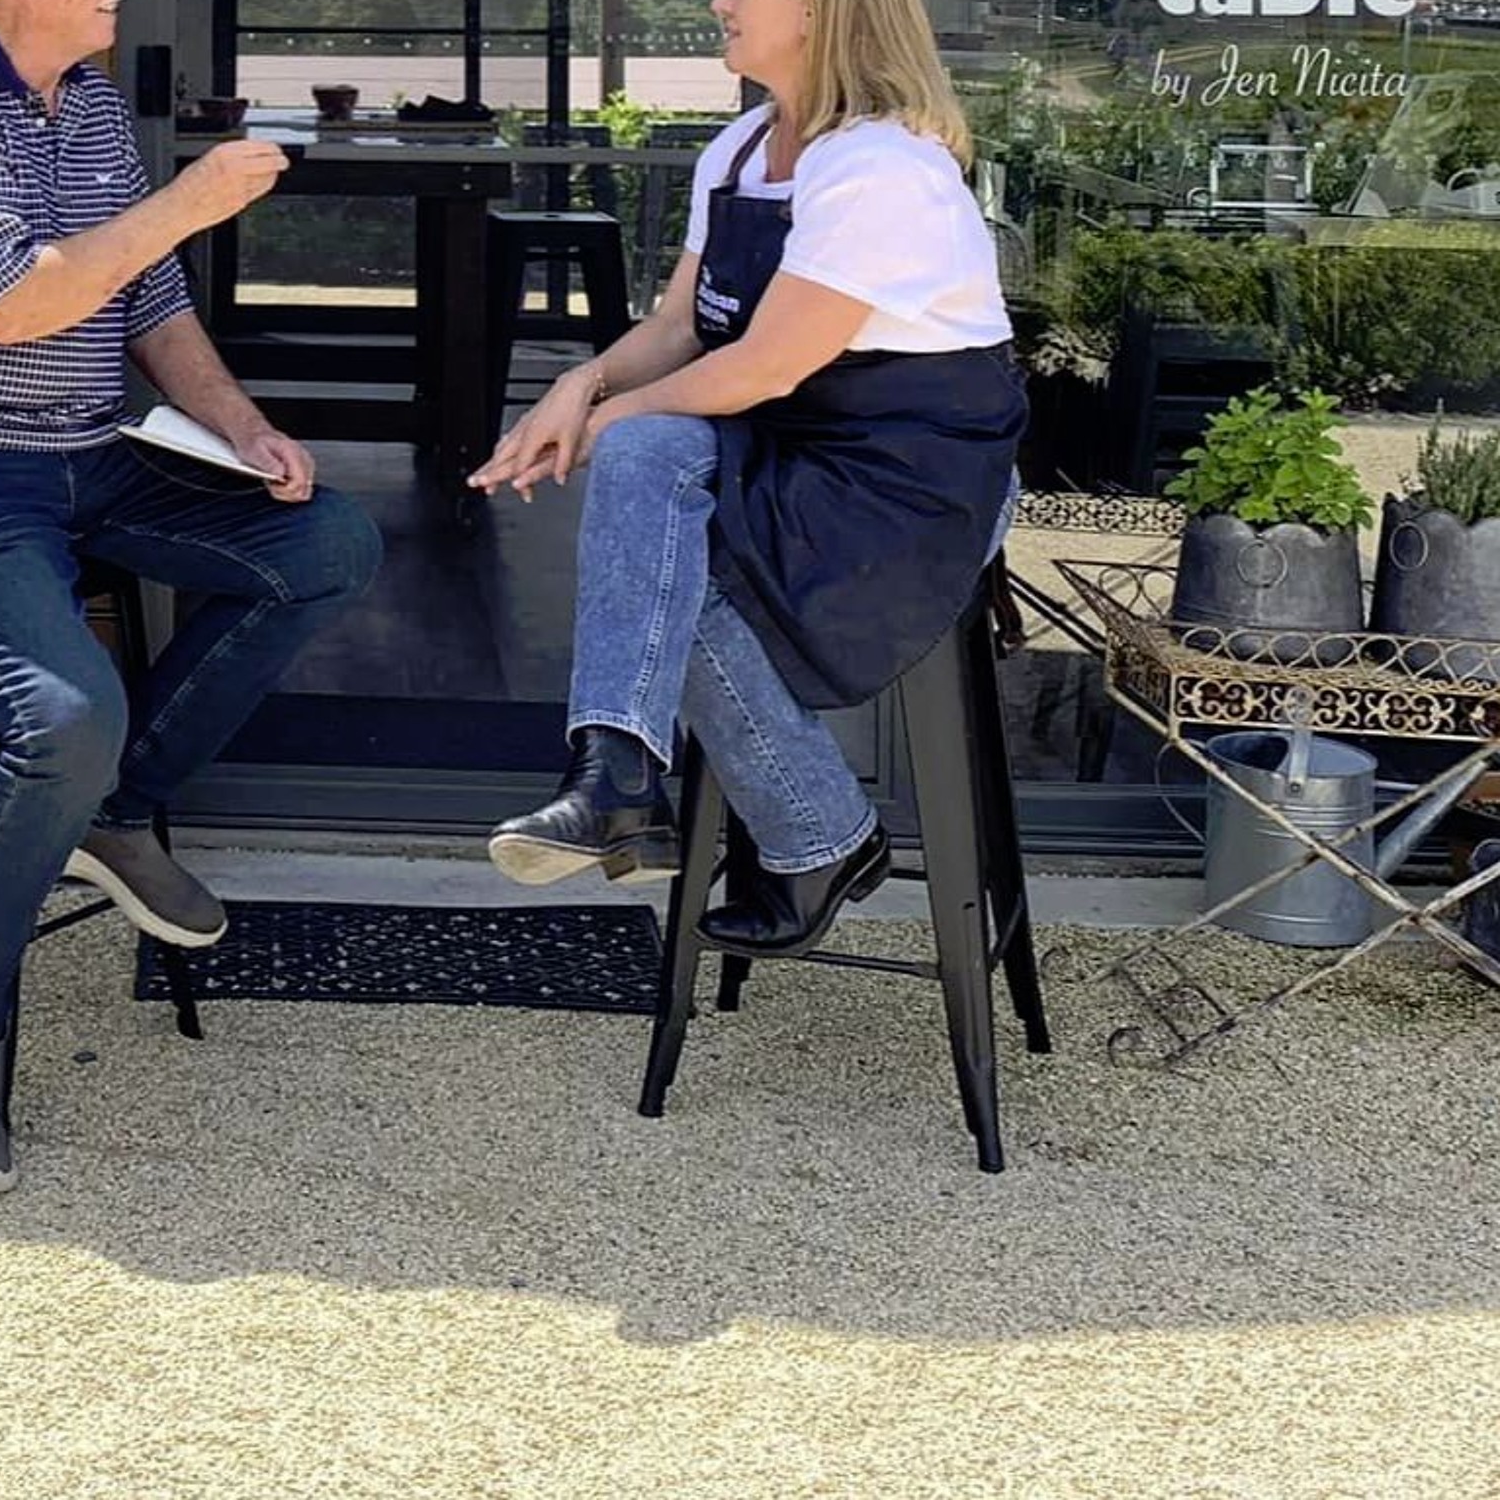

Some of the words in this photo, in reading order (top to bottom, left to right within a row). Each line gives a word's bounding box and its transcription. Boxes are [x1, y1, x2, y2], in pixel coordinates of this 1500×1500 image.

[1150, 48, 1191, 108] by
[1199, 43, 1280, 108] Jen
[1291, 44, 1410, 99] Nicita
